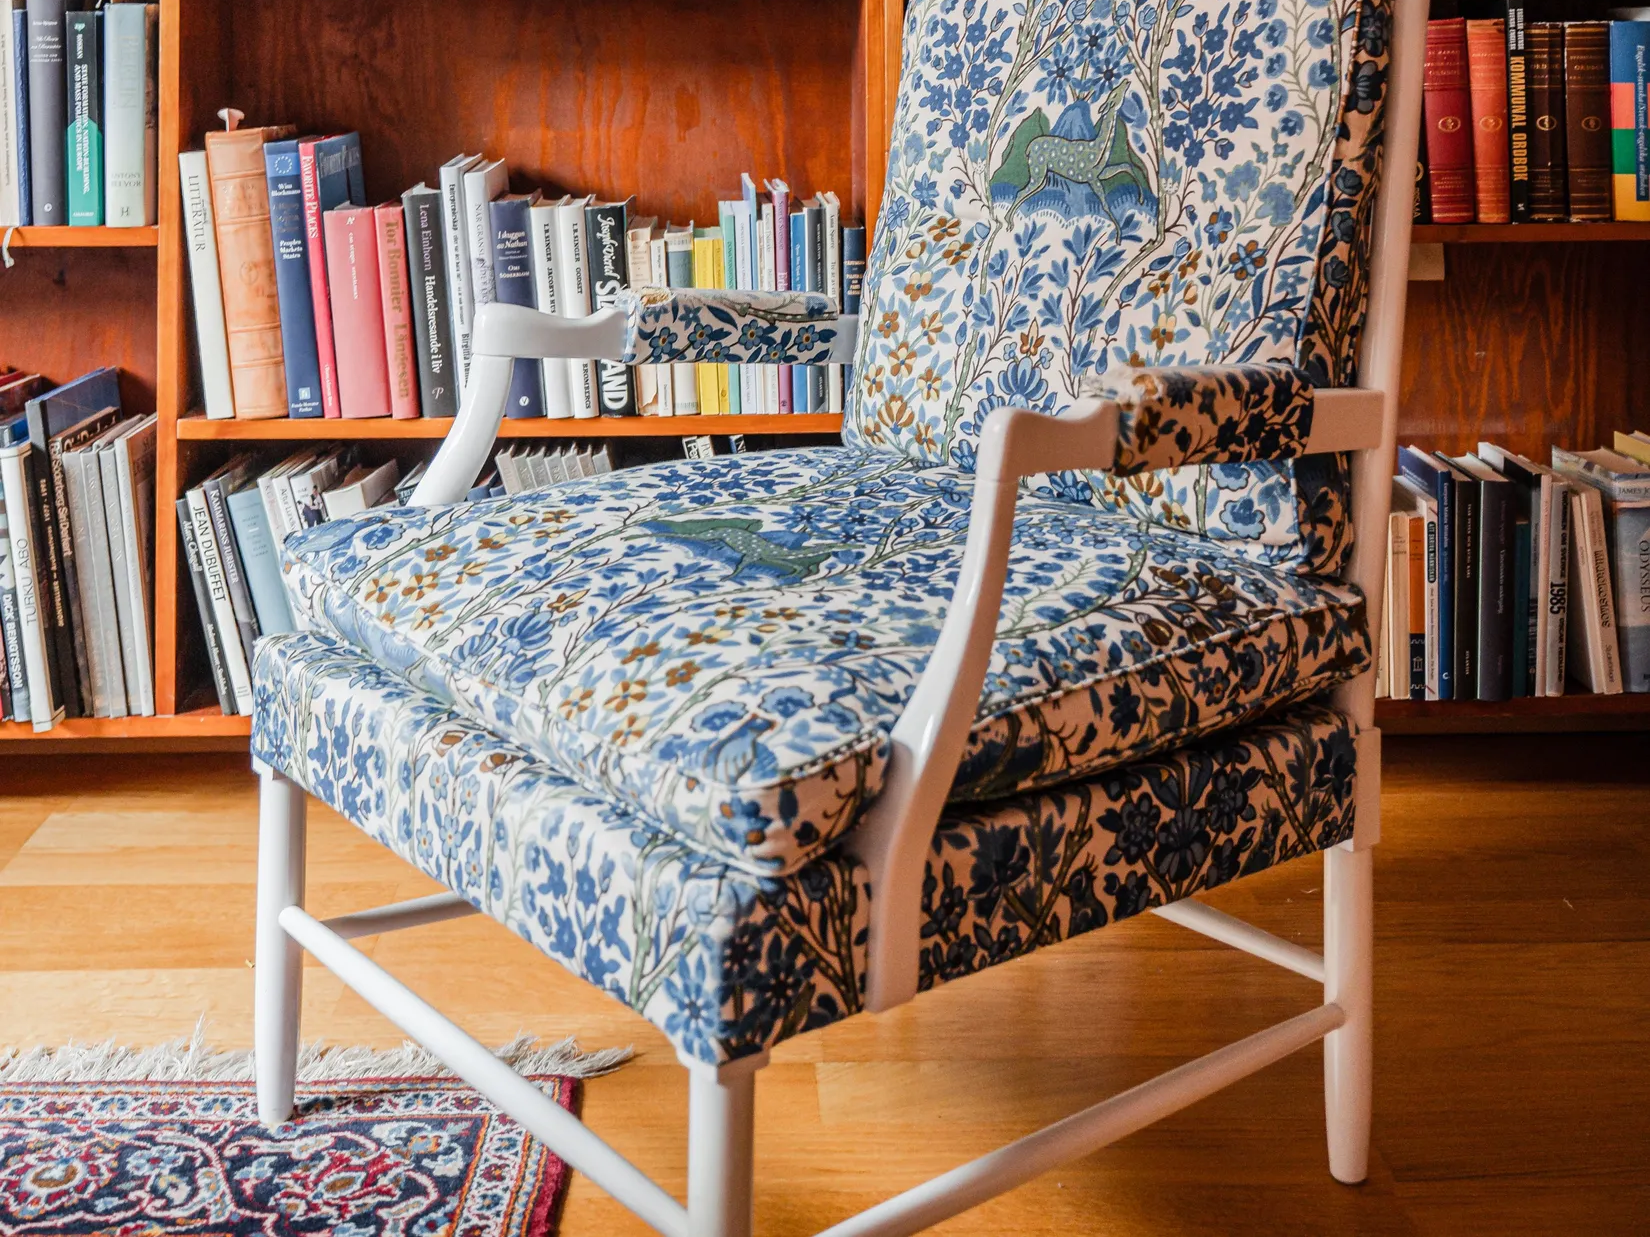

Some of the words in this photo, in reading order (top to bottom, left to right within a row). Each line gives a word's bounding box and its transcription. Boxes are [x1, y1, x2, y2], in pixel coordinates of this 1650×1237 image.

[1510, 56, 1526, 128] KOMMUNAL
[1512, 133, 1528, 181] ORDBOK
[188, 175, 206, 252] LITTERATUR
[306, 201, 319, 239] PLACES
[384, 219, 400, 246] Tor
[419, 204, 430, 228] Lena
[421, 231, 434, 271] Einhorn
[387, 249, 404, 313] Bonnier
[424, 276, 440, 353] Handelsresande
[431, 359, 442, 374] liv
[582, 363, 591, 409] BROMBERGS
[182, 521, 195, 540] Marc
[210, 489, 229, 545] KAMMARENS
[221, 547, 239, 584] JURISTER
[1560, 533, 1568, 546] OM
[187, 542, 203, 573] Chagall
[193, 506, 209, 536] JEAN
[201, 541, 226, 602] DUBUFFET
[1560, 548, 1568, 579] SVERIGE
[2, 593, 15, 621] DICK
[1549, 581, 1567, 614] 1985
[6, 622, 23, 688] BENGTSSON
